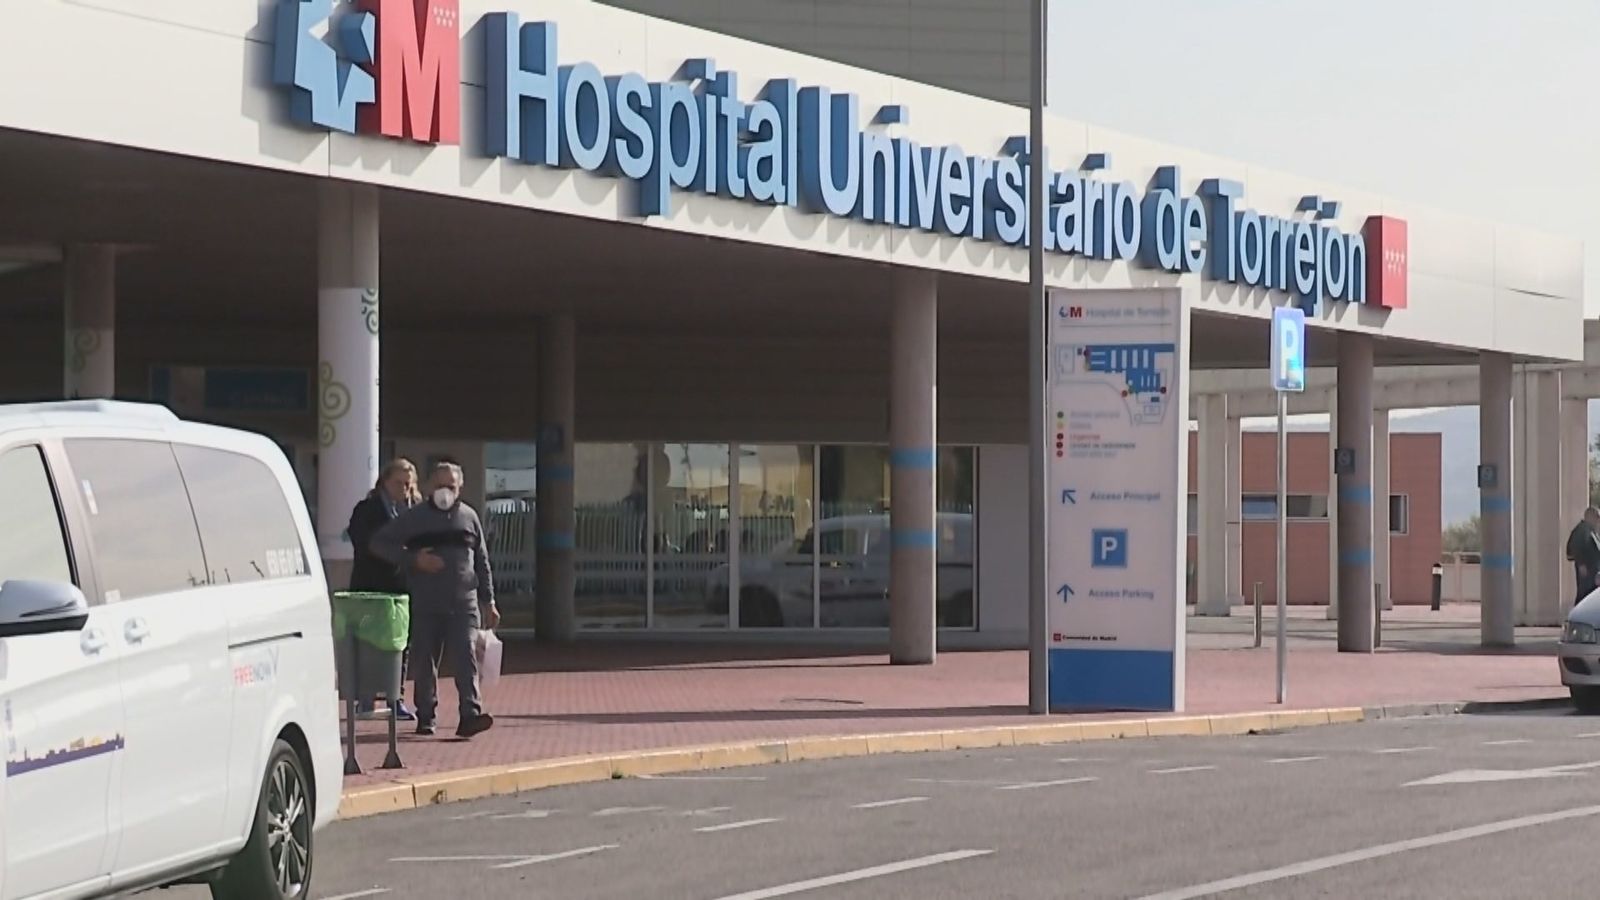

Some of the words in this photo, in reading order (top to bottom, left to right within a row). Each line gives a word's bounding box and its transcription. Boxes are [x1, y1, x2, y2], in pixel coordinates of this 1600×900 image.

[506, 11, 797, 217] Hospital
[819, 87, 1141, 262] Universitario
[1155, 164, 1208, 274] de
[1218, 178, 1367, 318] Torrejón
[1070, 307, 1082, 318] M
[1279, 318, 1298, 380] P
[1090, 491, 1122, 500] Acceso
[1124, 491, 1161, 502] Principal
[1101, 536, 1118, 561] P
[1089, 588, 1120, 598] Acceso
[1122, 588, 1154, 600] Parking
